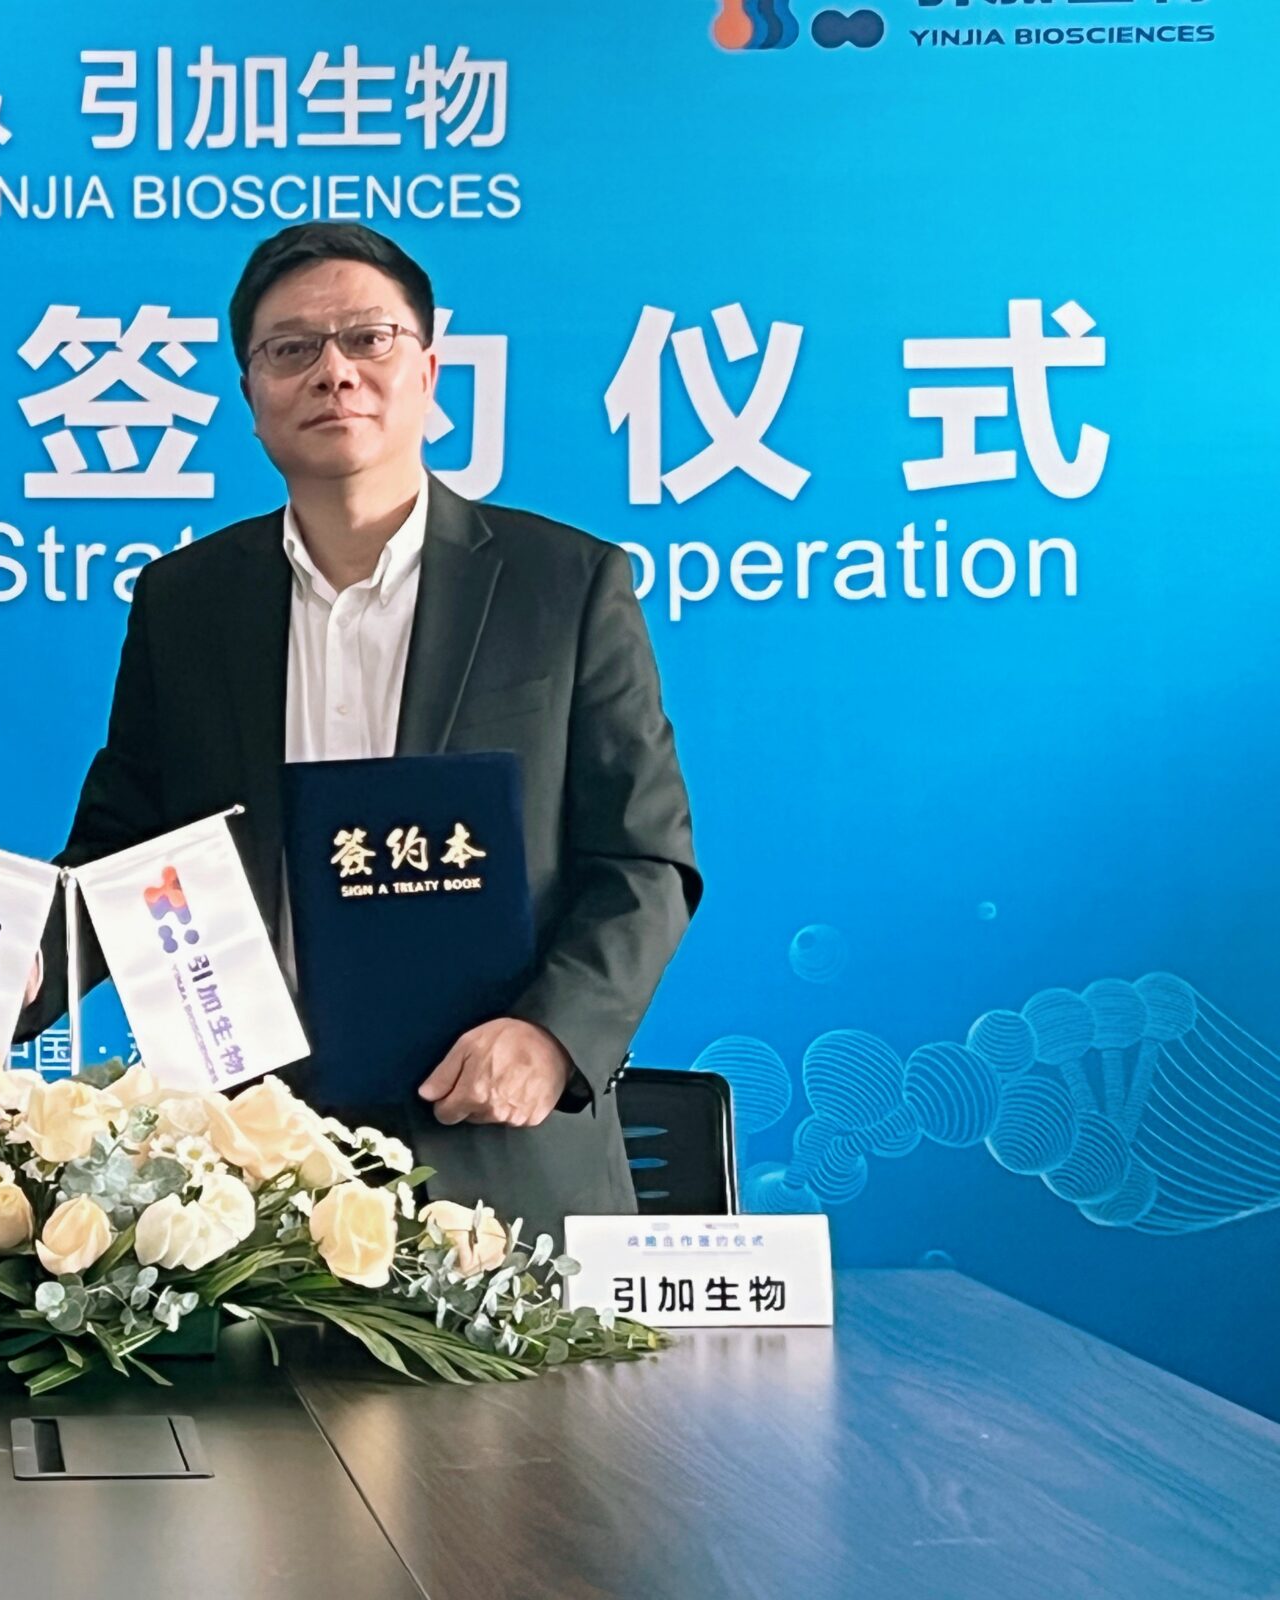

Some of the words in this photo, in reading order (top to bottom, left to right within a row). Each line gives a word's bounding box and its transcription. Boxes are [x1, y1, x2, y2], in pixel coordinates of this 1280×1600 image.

[909, 29, 1005, 46] YINJIA
[1015, 25, 1215, 45] BIOSCIENCES
[81, 45, 508, 150] 引加生物
[134, 174, 521, 219] BIOSCIENCES
[341, 884, 373, 897] SIGN
[378, 883, 389, 895] A
[393, 880, 439, 893] TREATY
[443, 878, 482, 891] BOOK
[188, 954, 245, 1075] 引加生物
[613, 1275, 786, 1312] 引加生物
